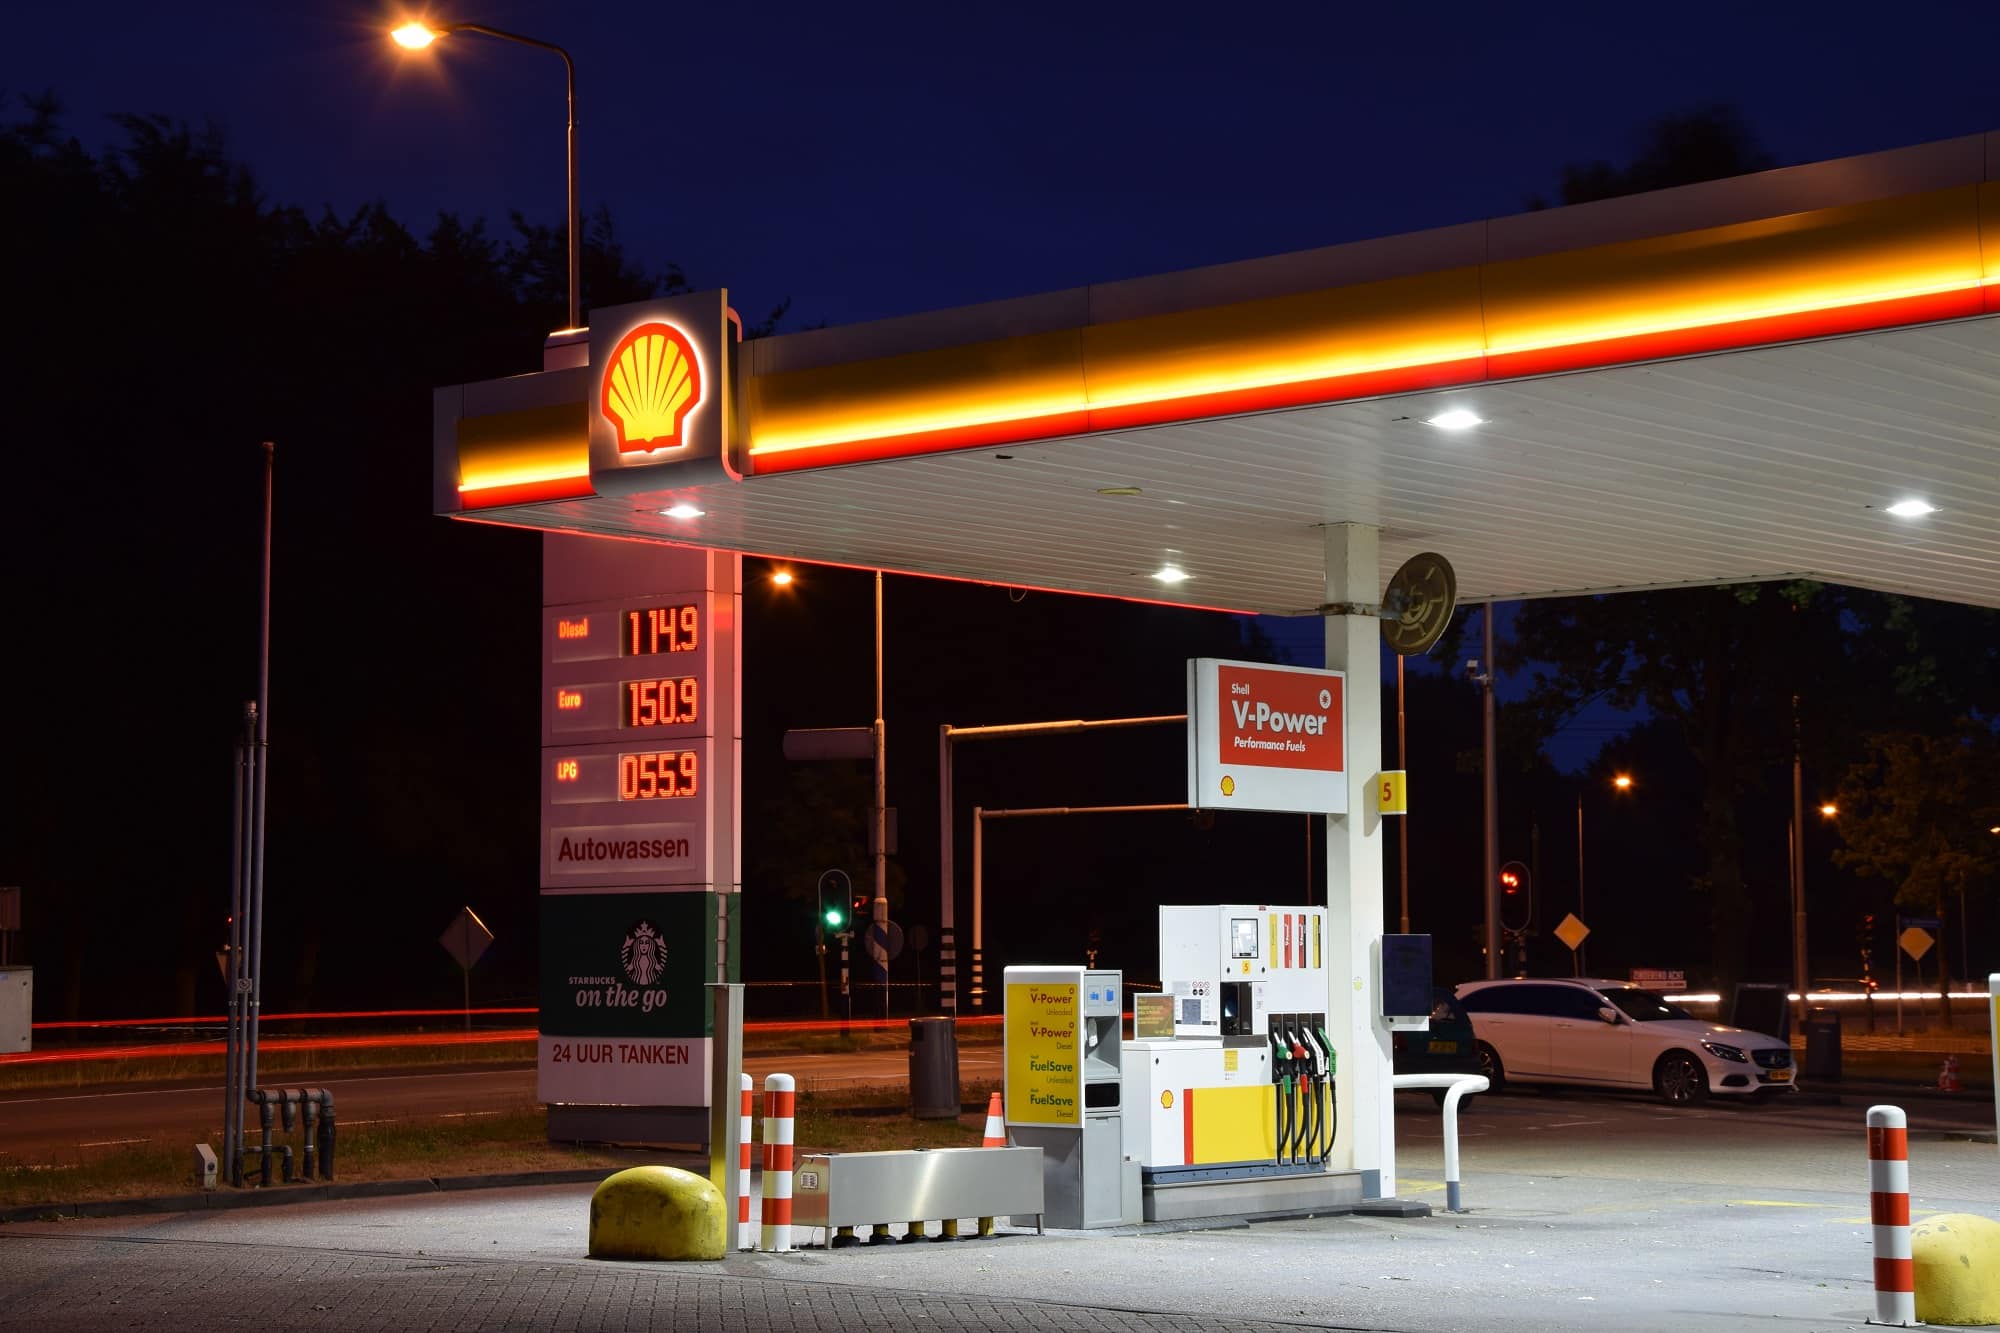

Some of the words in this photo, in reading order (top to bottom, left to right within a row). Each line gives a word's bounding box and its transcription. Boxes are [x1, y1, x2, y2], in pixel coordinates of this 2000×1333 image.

[559, 618, 588, 639] Diesel
[1231, 683, 1250, 695] Shell
[558, 690, 581, 709] Euro
[630, 678, 697, 726] 150.9
[1231, 700, 1328, 736] V-Power
[1233, 736, 1285, 751] Performance
[1286, 740, 1306, 752] Fuels
[557, 760, 578, 781] LPG
[621, 751, 697, 800] 055.9
[1382, 782, 1392, 802] 5
[558, 837, 690, 862] Autowassen
[1243, 963, 1249, 972] 5
[568, 976, 616, 985] STARBUCKS
[576, 989, 602, 1007] on
[605, 983, 639, 1007] the
[642, 989, 667, 1013] go
[1030, 993, 1073, 1004] V-Power
[1030, 1027, 1073, 1038] V-Power
[552, 1044, 571, 1063] 24
[576, 1044, 613, 1064] UUR
[618, 1044, 689, 1065] TANKEN
[1030, 1060, 1073, 1072] FuelSave
[1030, 1094, 1073, 1106] FuelSave
